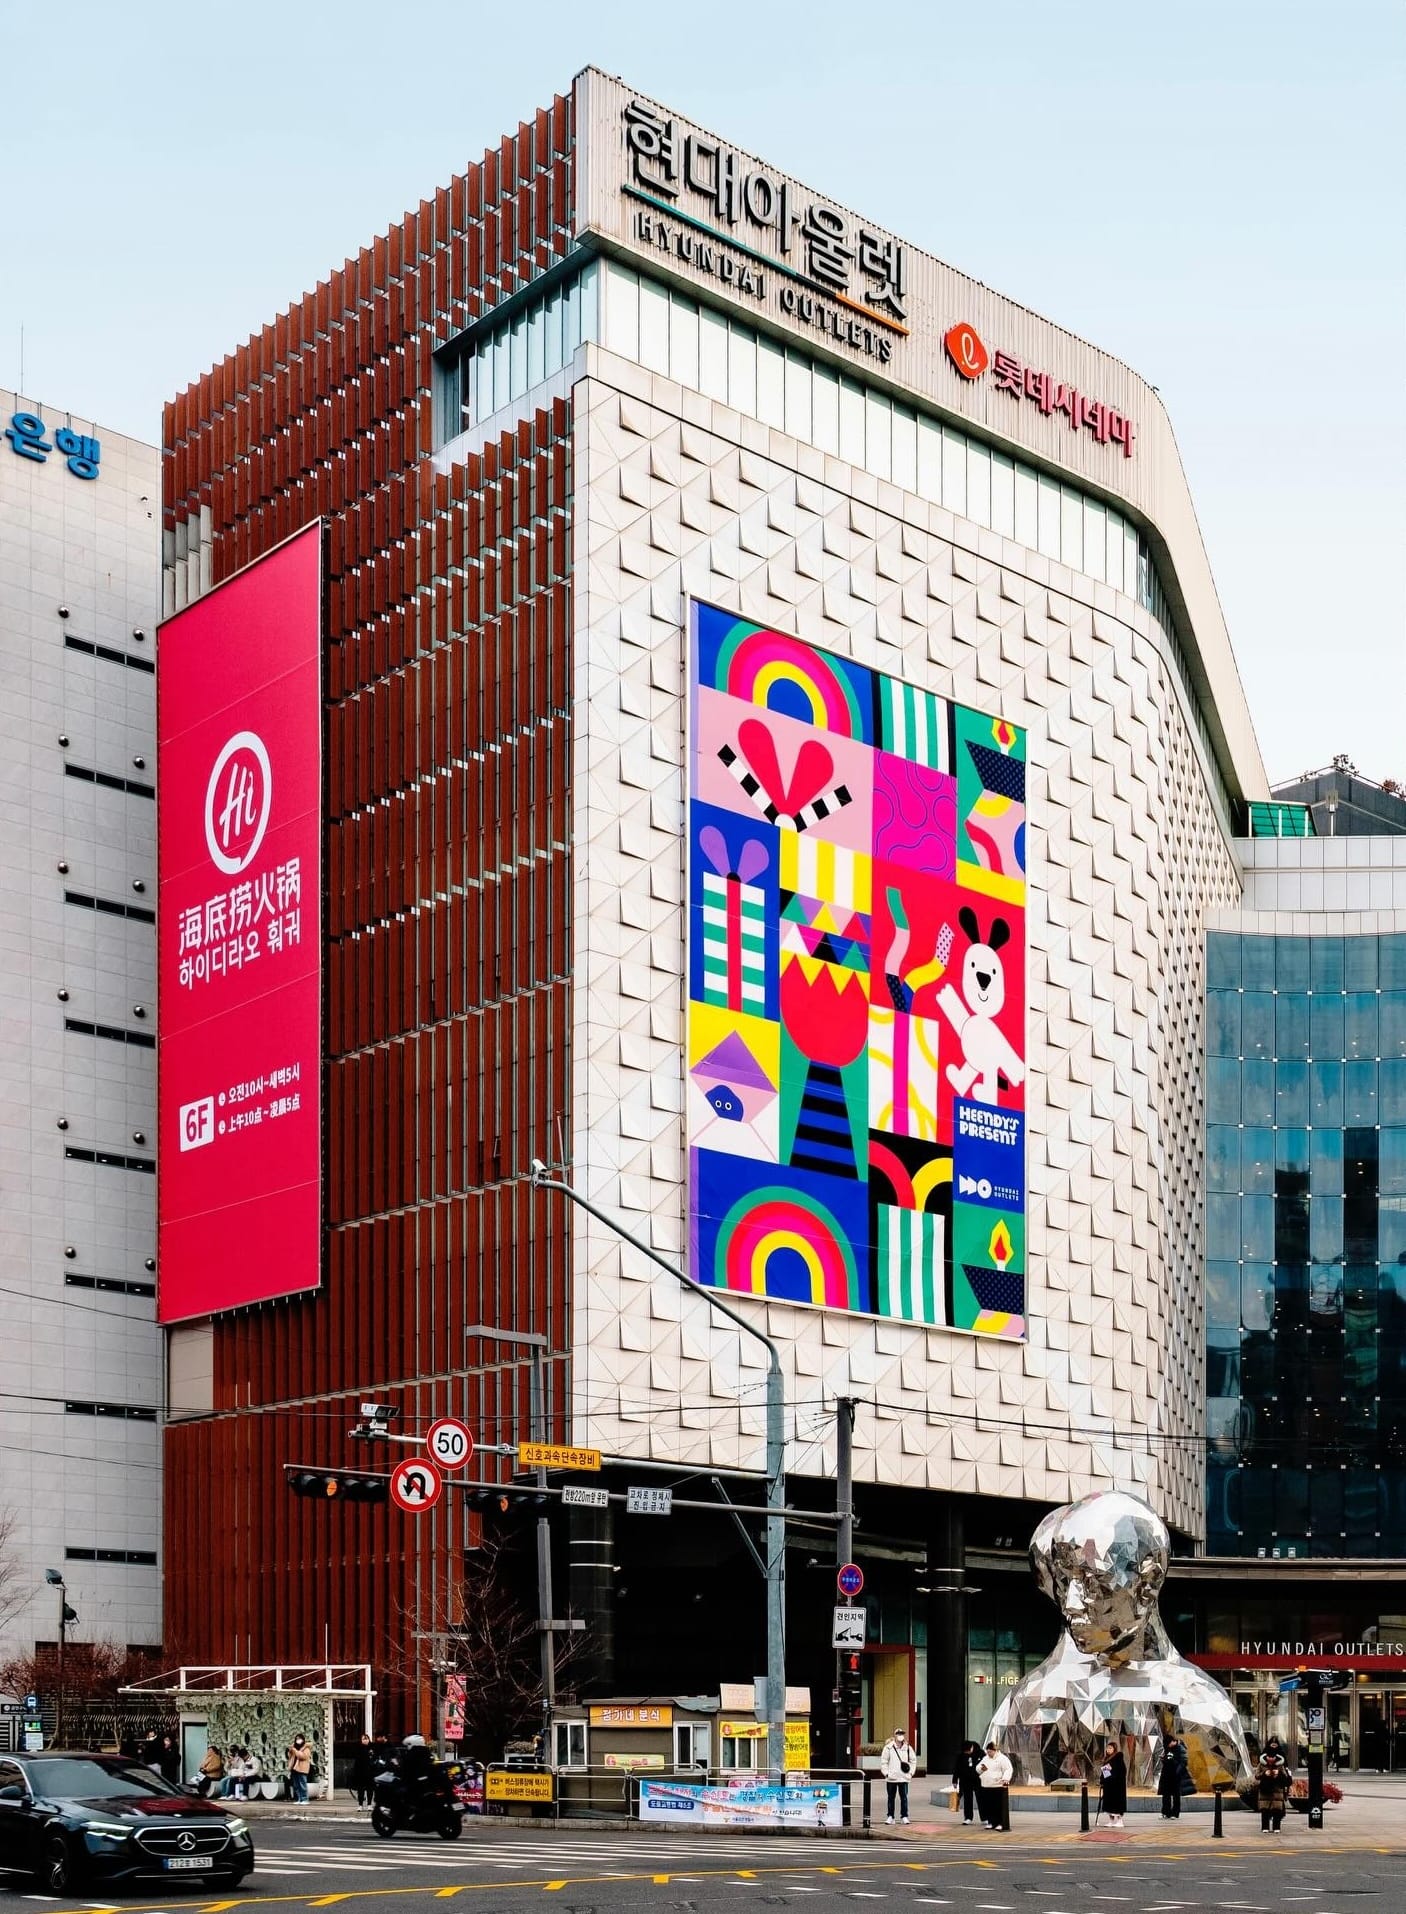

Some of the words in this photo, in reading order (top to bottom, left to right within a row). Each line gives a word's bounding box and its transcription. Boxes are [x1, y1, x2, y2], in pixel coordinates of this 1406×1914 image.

[624, 99, 908, 319] 현대아울렛
[634, 211, 766, 300] HYUNDAI
[781, 286, 893, 362] OUTLETS
[993, 350, 1134, 458] 롯데시네마
[5, 412, 101, 480] 은행
[219, 762, 257, 848] Hi
[178, 856, 301, 957] 海底捞火锅
[179, 930, 261, 991] 하이디라오
[186, 1103, 209, 1143] 6F
[959, 1120, 1018, 1146] PRESENT
[437, 1432, 463, 1455] 50
[525, 1448, 595, 1466] 신호과속단속장비
[630, 1489, 649, 1500] 교차로
[837, 1612, 864, 1621] 견인지역
[1241, 1641, 1324, 1656] HYUNDAI
[1334, 1642, 1404, 1656] OUTLETS
